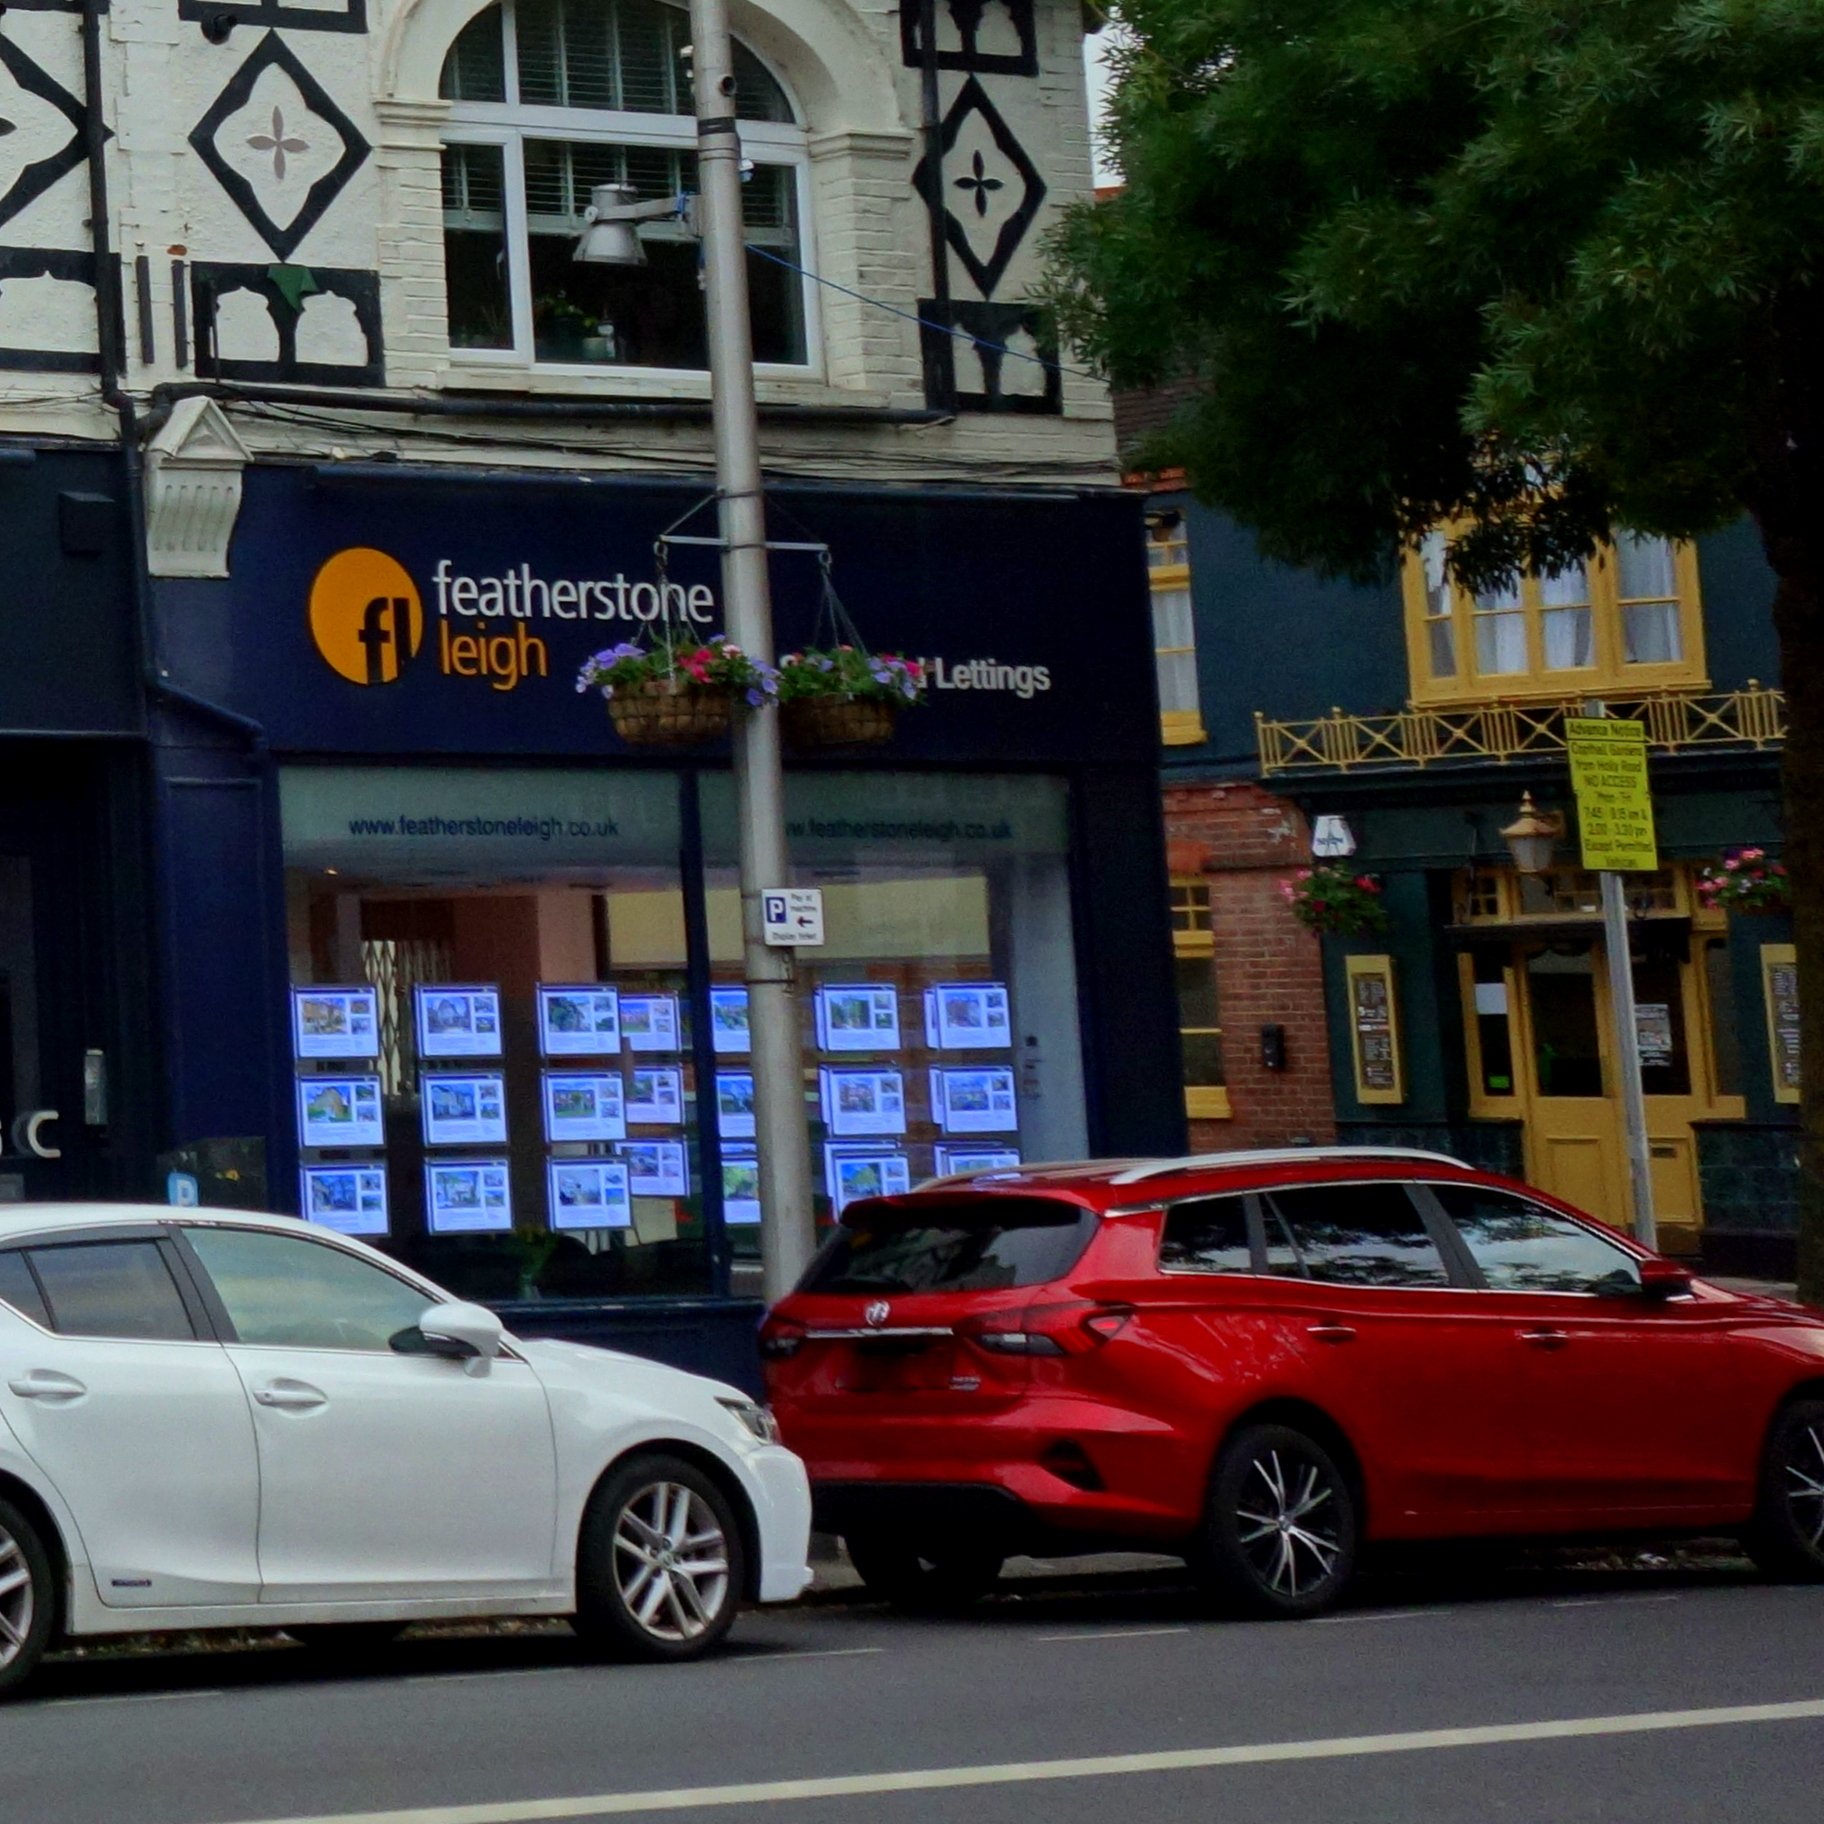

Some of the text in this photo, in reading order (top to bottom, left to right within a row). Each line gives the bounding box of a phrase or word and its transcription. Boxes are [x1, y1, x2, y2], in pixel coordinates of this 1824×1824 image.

[432, 559, 714, 624] featherstone
[439, 620, 548, 691] leigh
[935, 657, 1051, 699] Lettings
[349, 815, 619, 841] www.featherstoneleigh.co.uk
